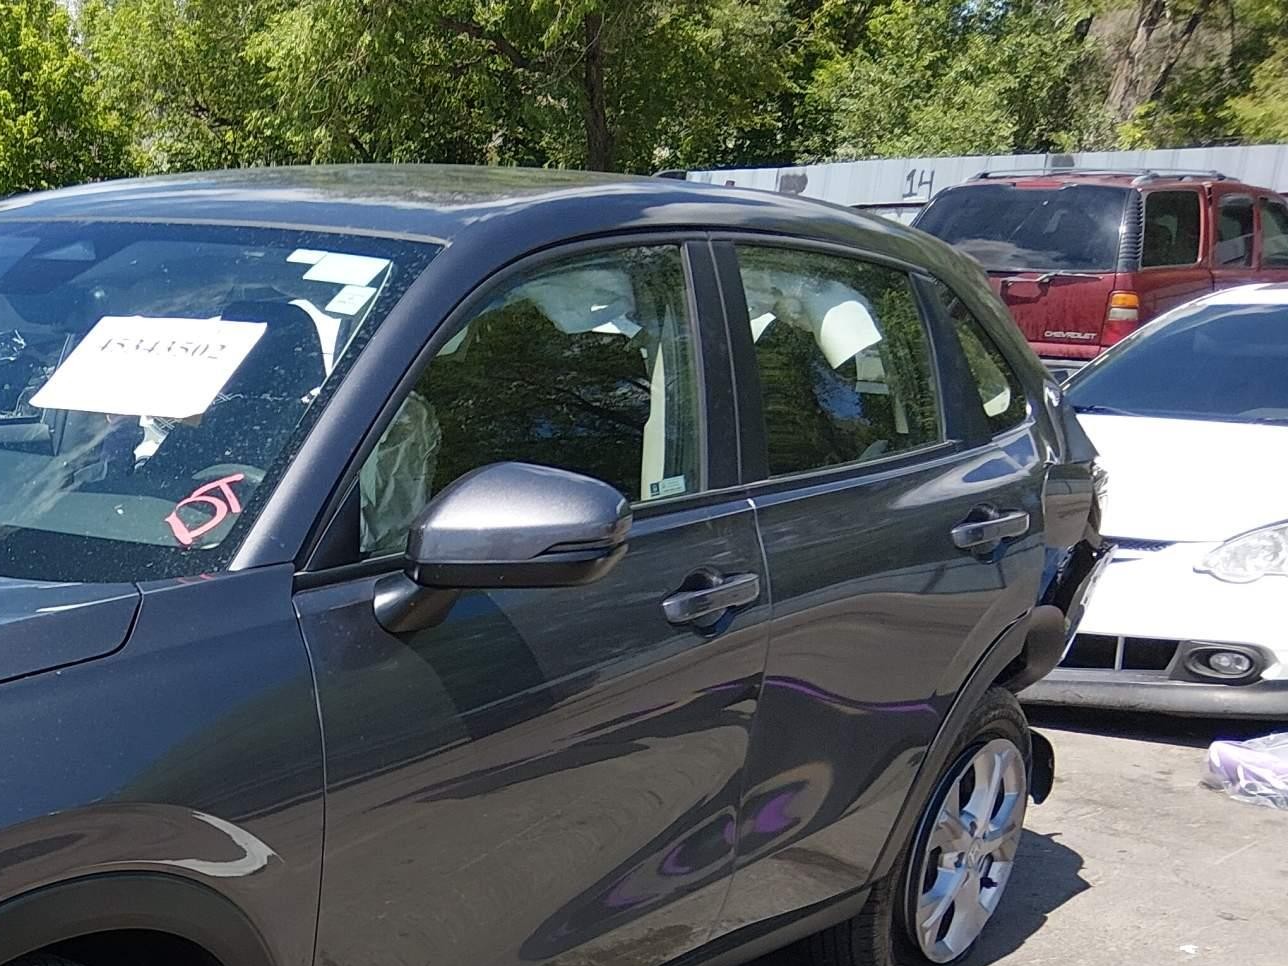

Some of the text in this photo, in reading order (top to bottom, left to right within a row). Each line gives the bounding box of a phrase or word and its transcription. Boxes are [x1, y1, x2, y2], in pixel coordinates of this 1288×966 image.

[902, 168, 936, 200] 14
[1044, 331, 1097, 340] CHEVROLET
[165, 473, 245, 545] DT
